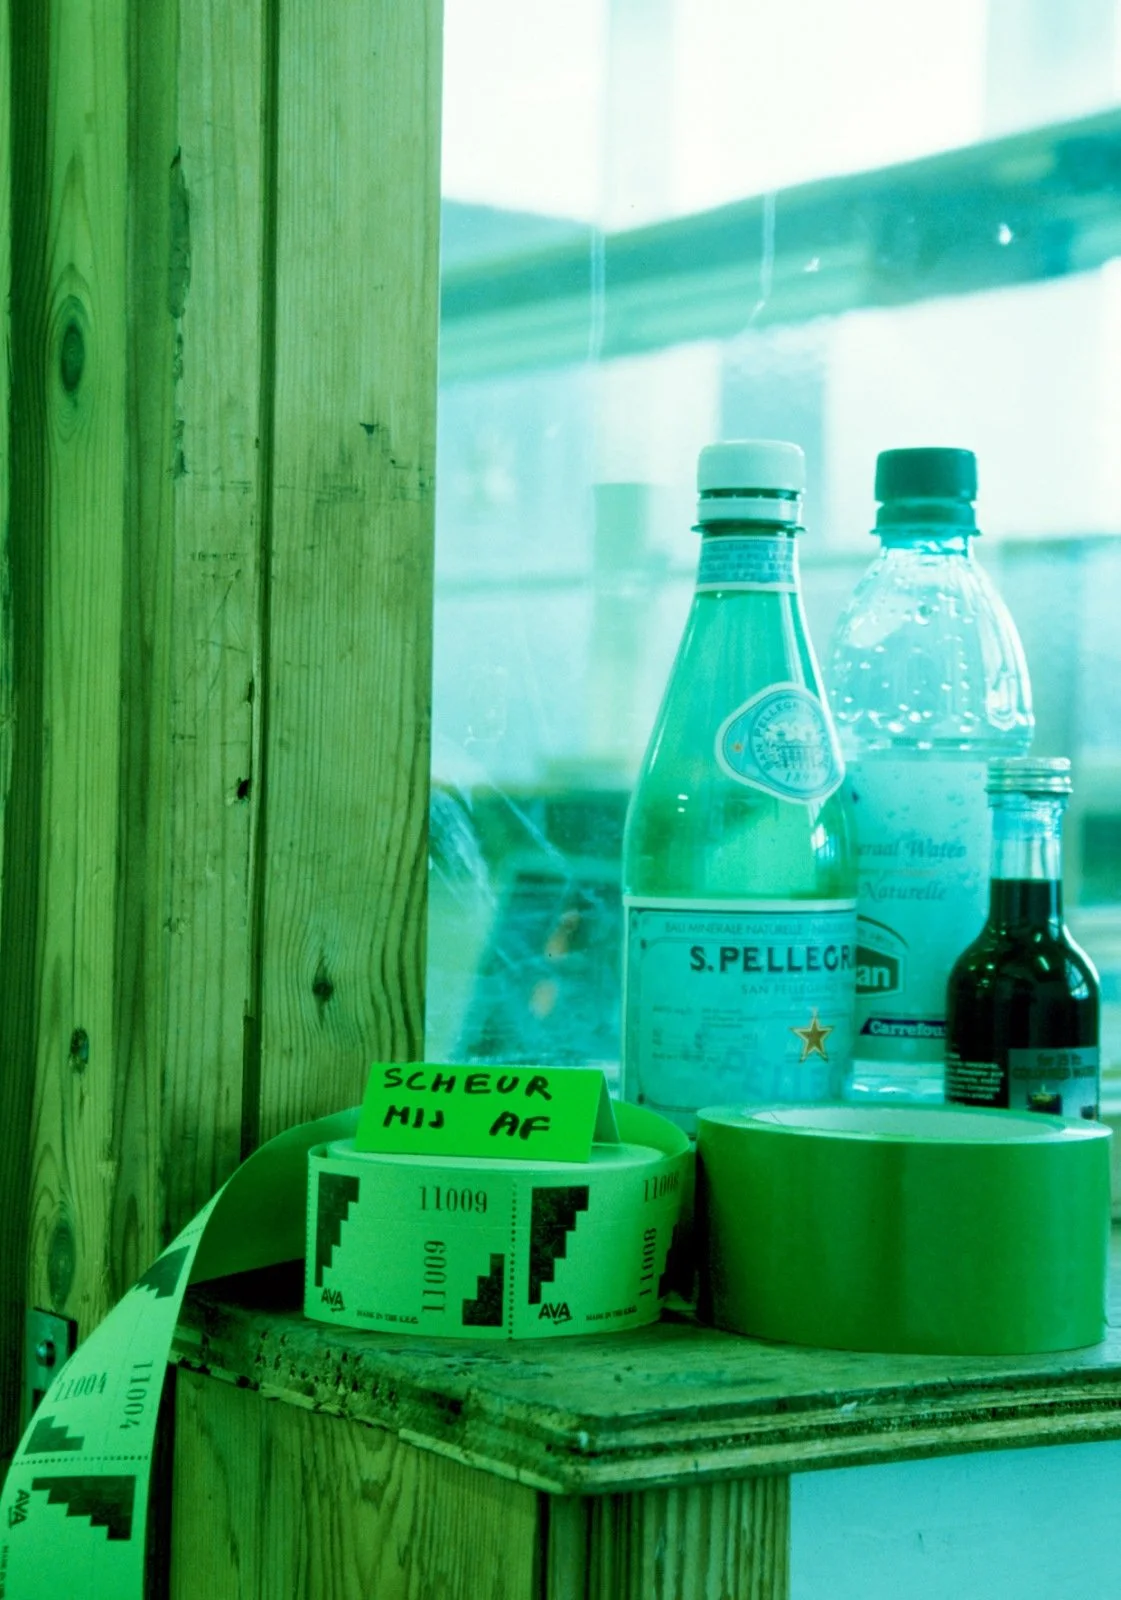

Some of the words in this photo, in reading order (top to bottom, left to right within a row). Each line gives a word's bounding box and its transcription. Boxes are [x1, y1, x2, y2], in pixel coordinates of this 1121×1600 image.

[861, 880, 947, 903] Naturelle
[741, 983, 769, 996] SAN
[869, 1019, 947, 1037] Carrefou
[383, 1067, 553, 1101] SCHEUR
[382, 1104, 446, 1129] MIJ
[488, 1110, 552, 1140] AF
[418, 1185, 488, 1214] 11009
[421, 1239, 449, 1315] 11009
[639, 1228, 657, 1296] 11008
[320, 1288, 345, 1310] AVA
[538, 1301, 573, 1323] AVA
[53, 1371, 108, 1402] 11004
[119, 1360, 153, 1430] 11004
[9, 1488, 31, 1528] AVA
